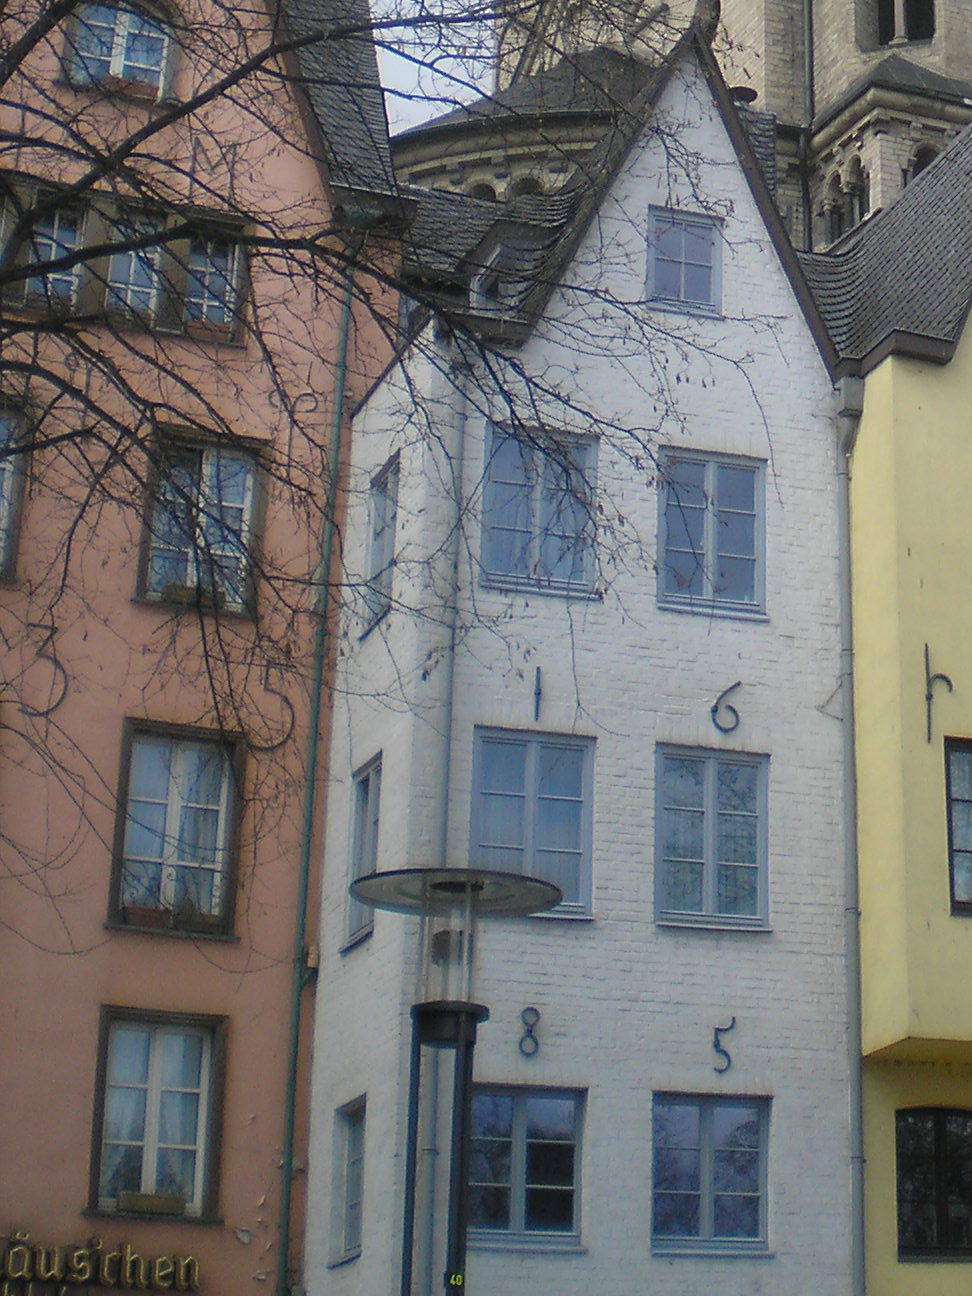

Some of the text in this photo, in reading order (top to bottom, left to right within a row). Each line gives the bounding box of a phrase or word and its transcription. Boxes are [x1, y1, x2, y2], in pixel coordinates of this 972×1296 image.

[710, 680, 742, 734] 6
[518, 1006, 736, 1074] 8 5
[449, 1274, 464, 1286] 40
